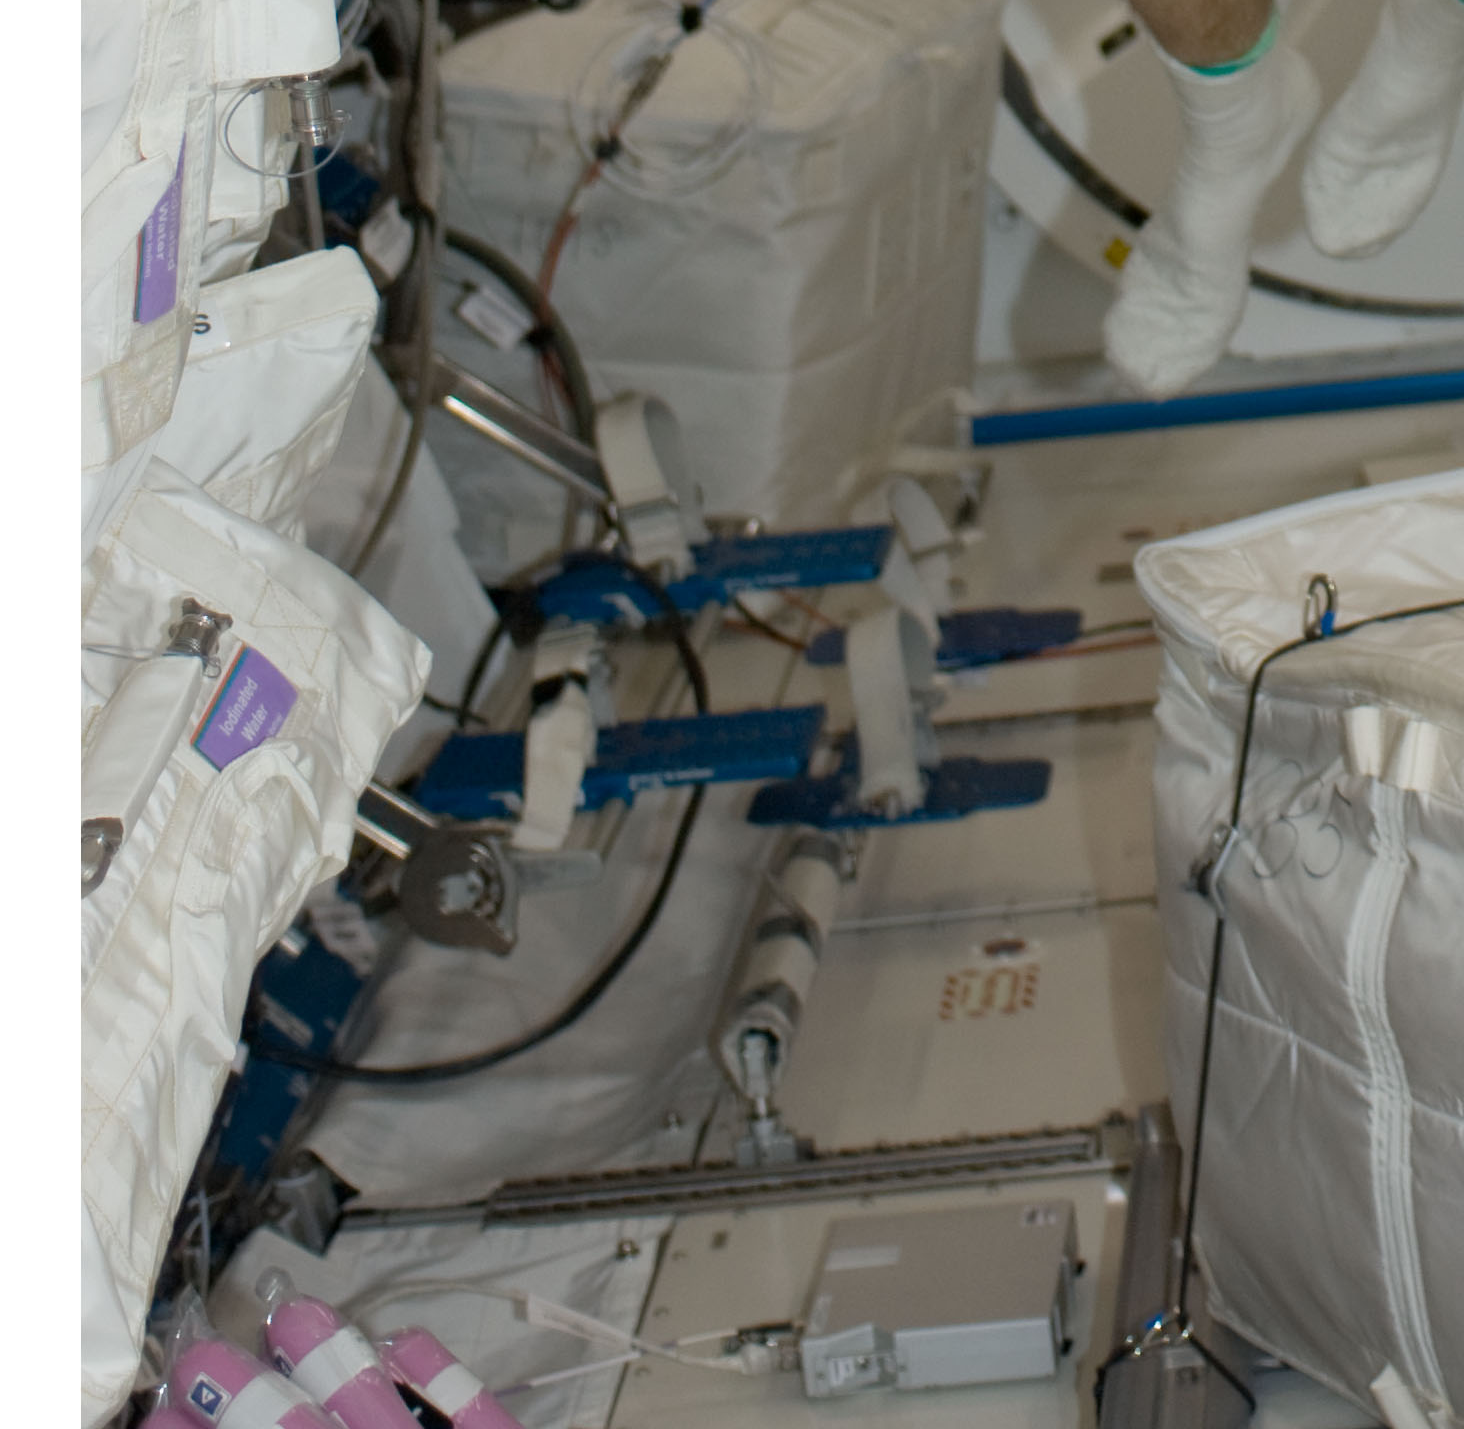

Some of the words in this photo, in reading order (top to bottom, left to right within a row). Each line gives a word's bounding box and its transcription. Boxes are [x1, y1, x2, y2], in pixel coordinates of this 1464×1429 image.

[156, 200, 169, 261] Water
[218, 674, 259, 738] Iodinated
[240, 702, 269, 743] Water
